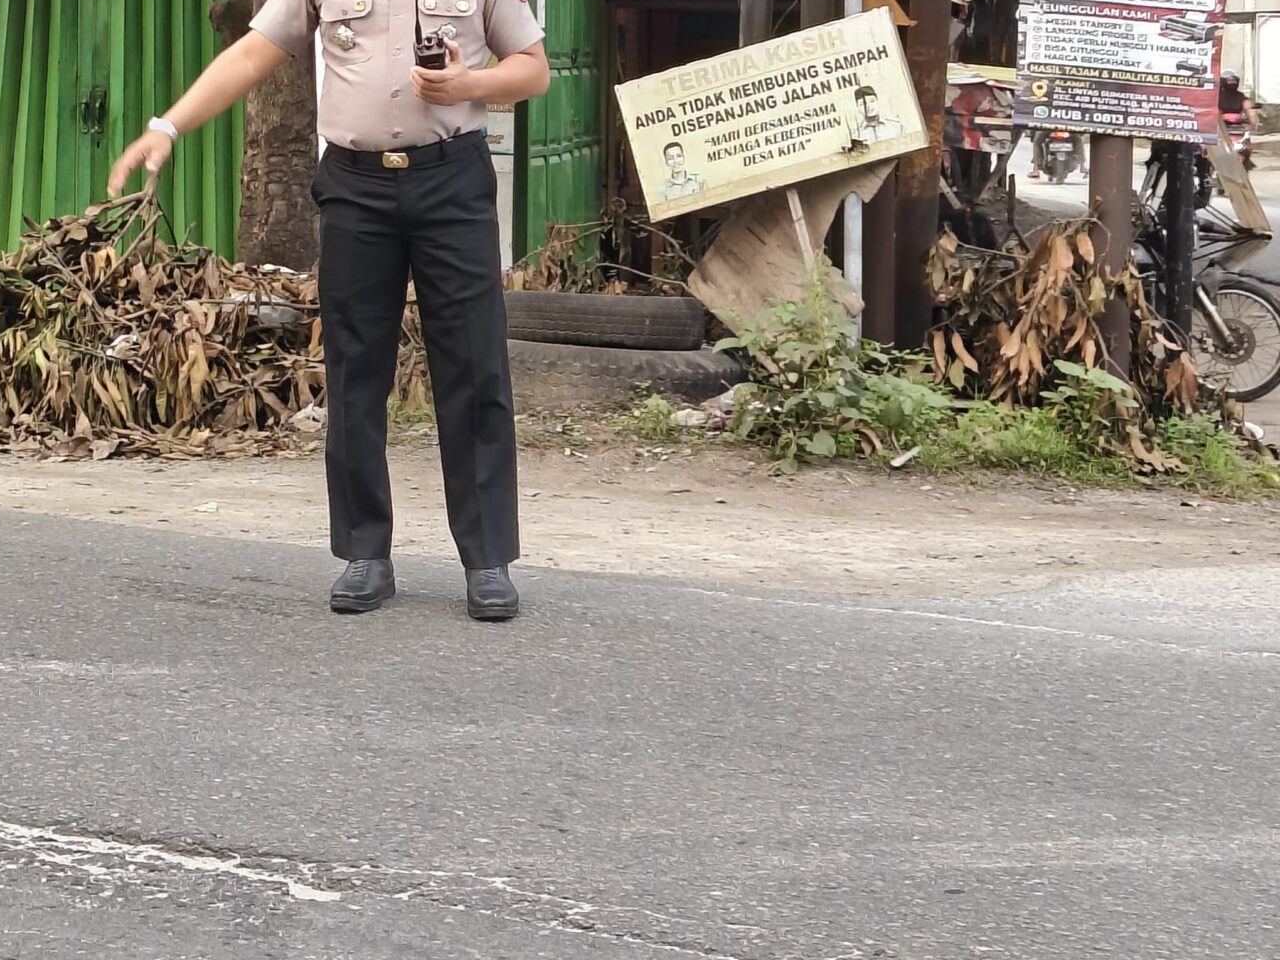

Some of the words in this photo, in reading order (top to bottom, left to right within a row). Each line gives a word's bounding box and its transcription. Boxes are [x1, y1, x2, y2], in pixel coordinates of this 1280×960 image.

[1122, 9, 1151, 20] KAMI
[661, 53, 760, 95] TERIMA
[767, 26, 847, 67] KASIH
[1029, 63, 1062, 74] HASIL
[1064, 66, 1099, 77] TAJAM
[1101, 70, 1109, 78] &
[1111, 71, 1160, 83] KUALITAS
[1163, 75, 1199, 86] BAGUS
[635, 105, 677, 130] ANDA
[678, 90, 726, 117] TIDAK
[728, 64, 820, 105] MEMBUANG
[823, 44, 889, 76] SAMPAH
[671, 95, 778, 138] DISEPANJANG
[782, 79, 833, 106] JALAN
[836, 71, 860, 91] INI
[743, 102, 838, 138] BERSAMA-SAMA
[1051, 108, 1081, 120] HUB
[1093, 112, 1124, 125] 0813
[706, 139, 763, 164] MENJAGA
[764, 115, 842, 147] KEBERSIHAN
[743, 152, 775, 168] DESA
